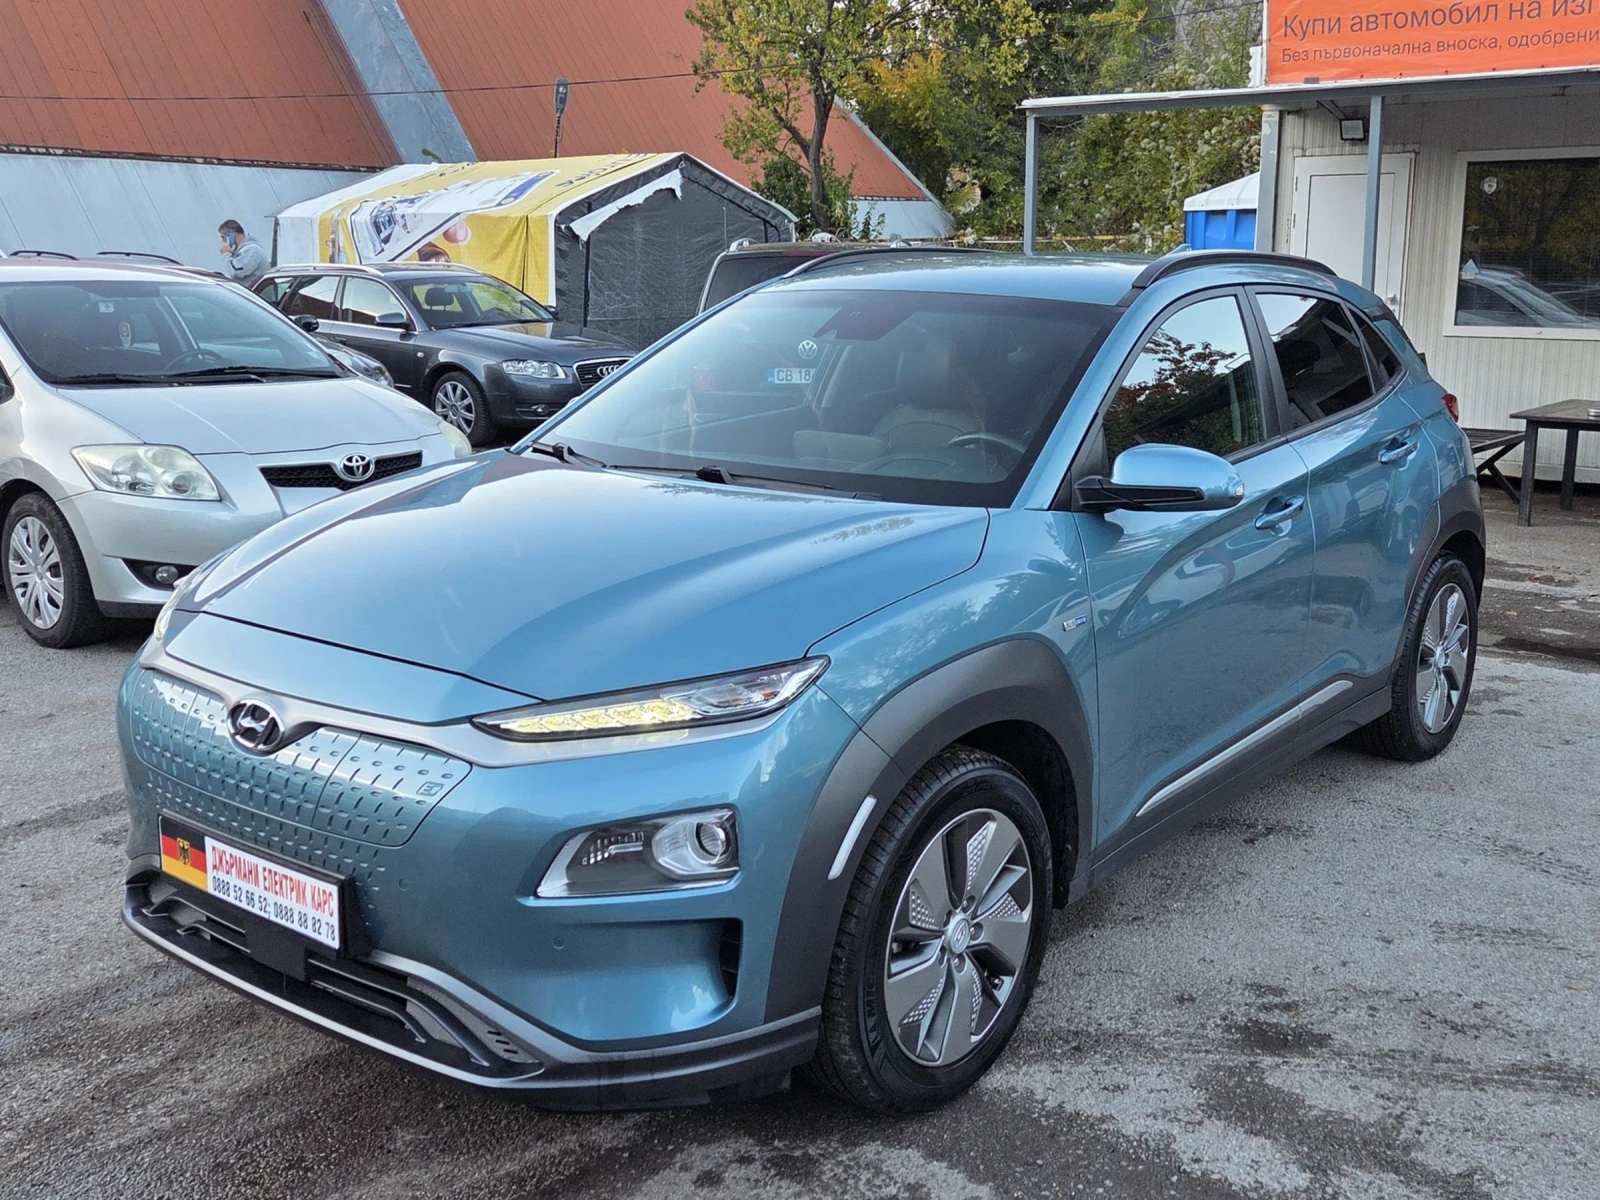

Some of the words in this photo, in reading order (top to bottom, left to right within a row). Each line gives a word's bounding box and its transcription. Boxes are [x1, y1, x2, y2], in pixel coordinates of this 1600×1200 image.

[1283, 14, 1342, 41] Купи
[1350, 1, 1499, 33] автомобил
[1508, 0, 1542, 20] на
[1282, 48, 1309, 63] Без
[1313, 41, 1431, 61] първоначална
[1436, 36, 1502, 52] вноска,
[1507, 29, 1600, 48] одобрени
[776, 369, 794, 382] CB
[211, 844, 260, 889] ДЖЪРМАНИ
[262, 865, 308, 908] ЕЛЕКТРИК
[310, 884, 335, 918] КАРС
[212, 875, 231, 898] 0888
[233, 884, 243, 903] 52
[245, 889, 256, 909] 66
[273, 901, 295, 924] 0888
[297, 910, 309, 930] 88
[311, 916, 322, 936] 82
[325, 921, 336, 942] 78
